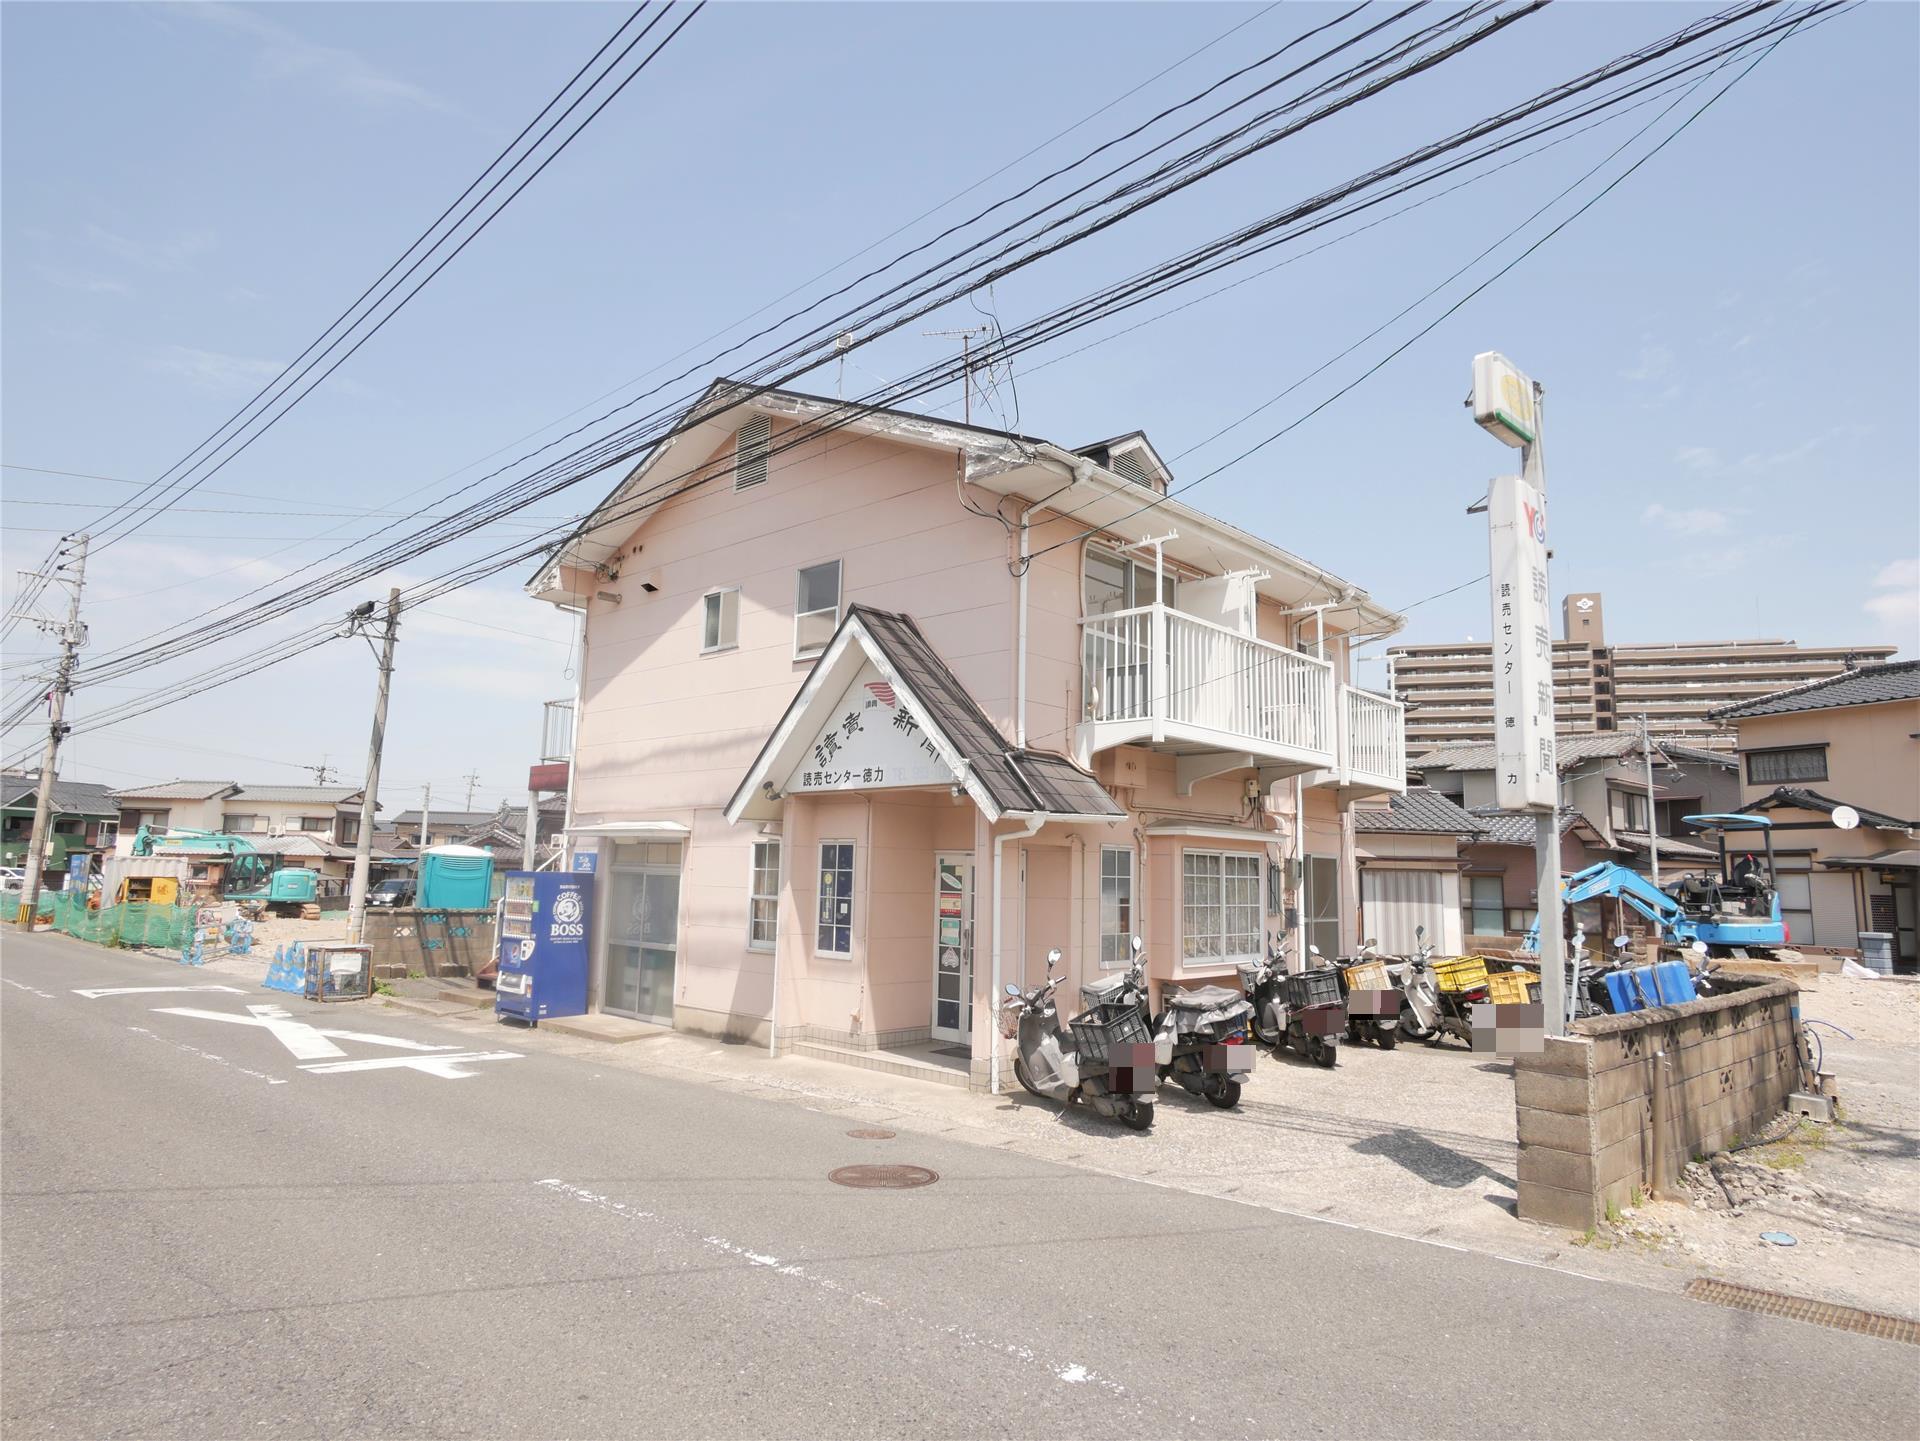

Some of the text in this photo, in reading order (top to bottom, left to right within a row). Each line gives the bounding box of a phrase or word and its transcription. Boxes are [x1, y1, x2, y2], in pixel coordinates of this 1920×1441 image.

[1532, 566, 1554, 775] 読売新聞
[803, 766, 884, 787] 読売センター徳力
[550, 923, 584, 936] BOSS
